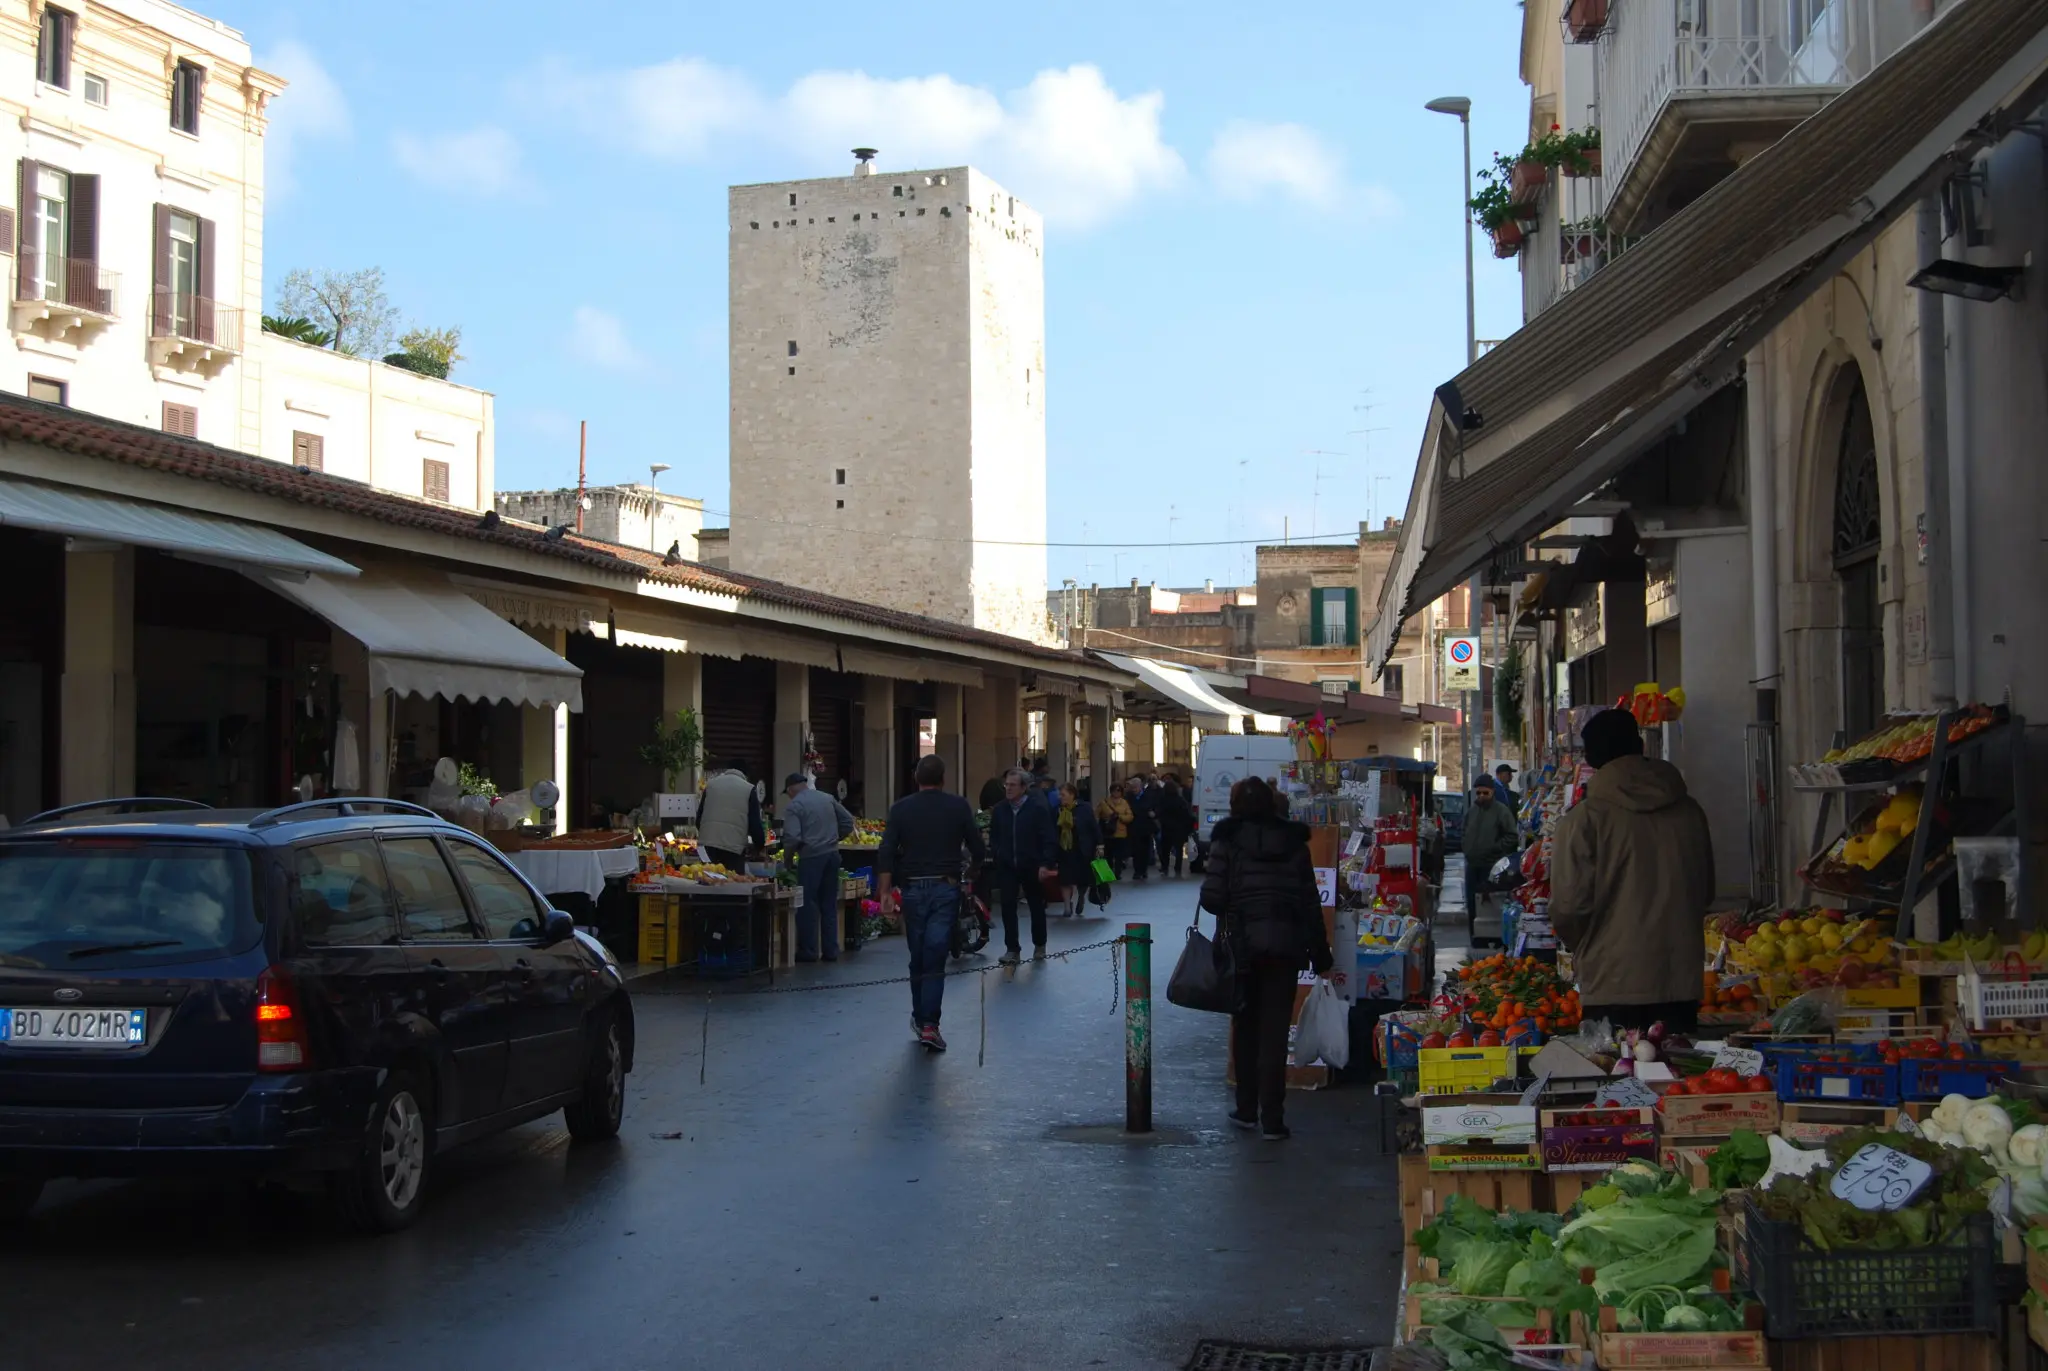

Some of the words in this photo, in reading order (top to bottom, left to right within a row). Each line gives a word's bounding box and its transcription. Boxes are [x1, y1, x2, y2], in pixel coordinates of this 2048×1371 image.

[15, 1011, 42, 1036] BD
[53, 1012, 127, 1039] 402MR
[130, 1028, 142, 1041] BA
[1463, 1117, 1488, 1126] GEA
[1859, 1144, 1879, 1161] 2
